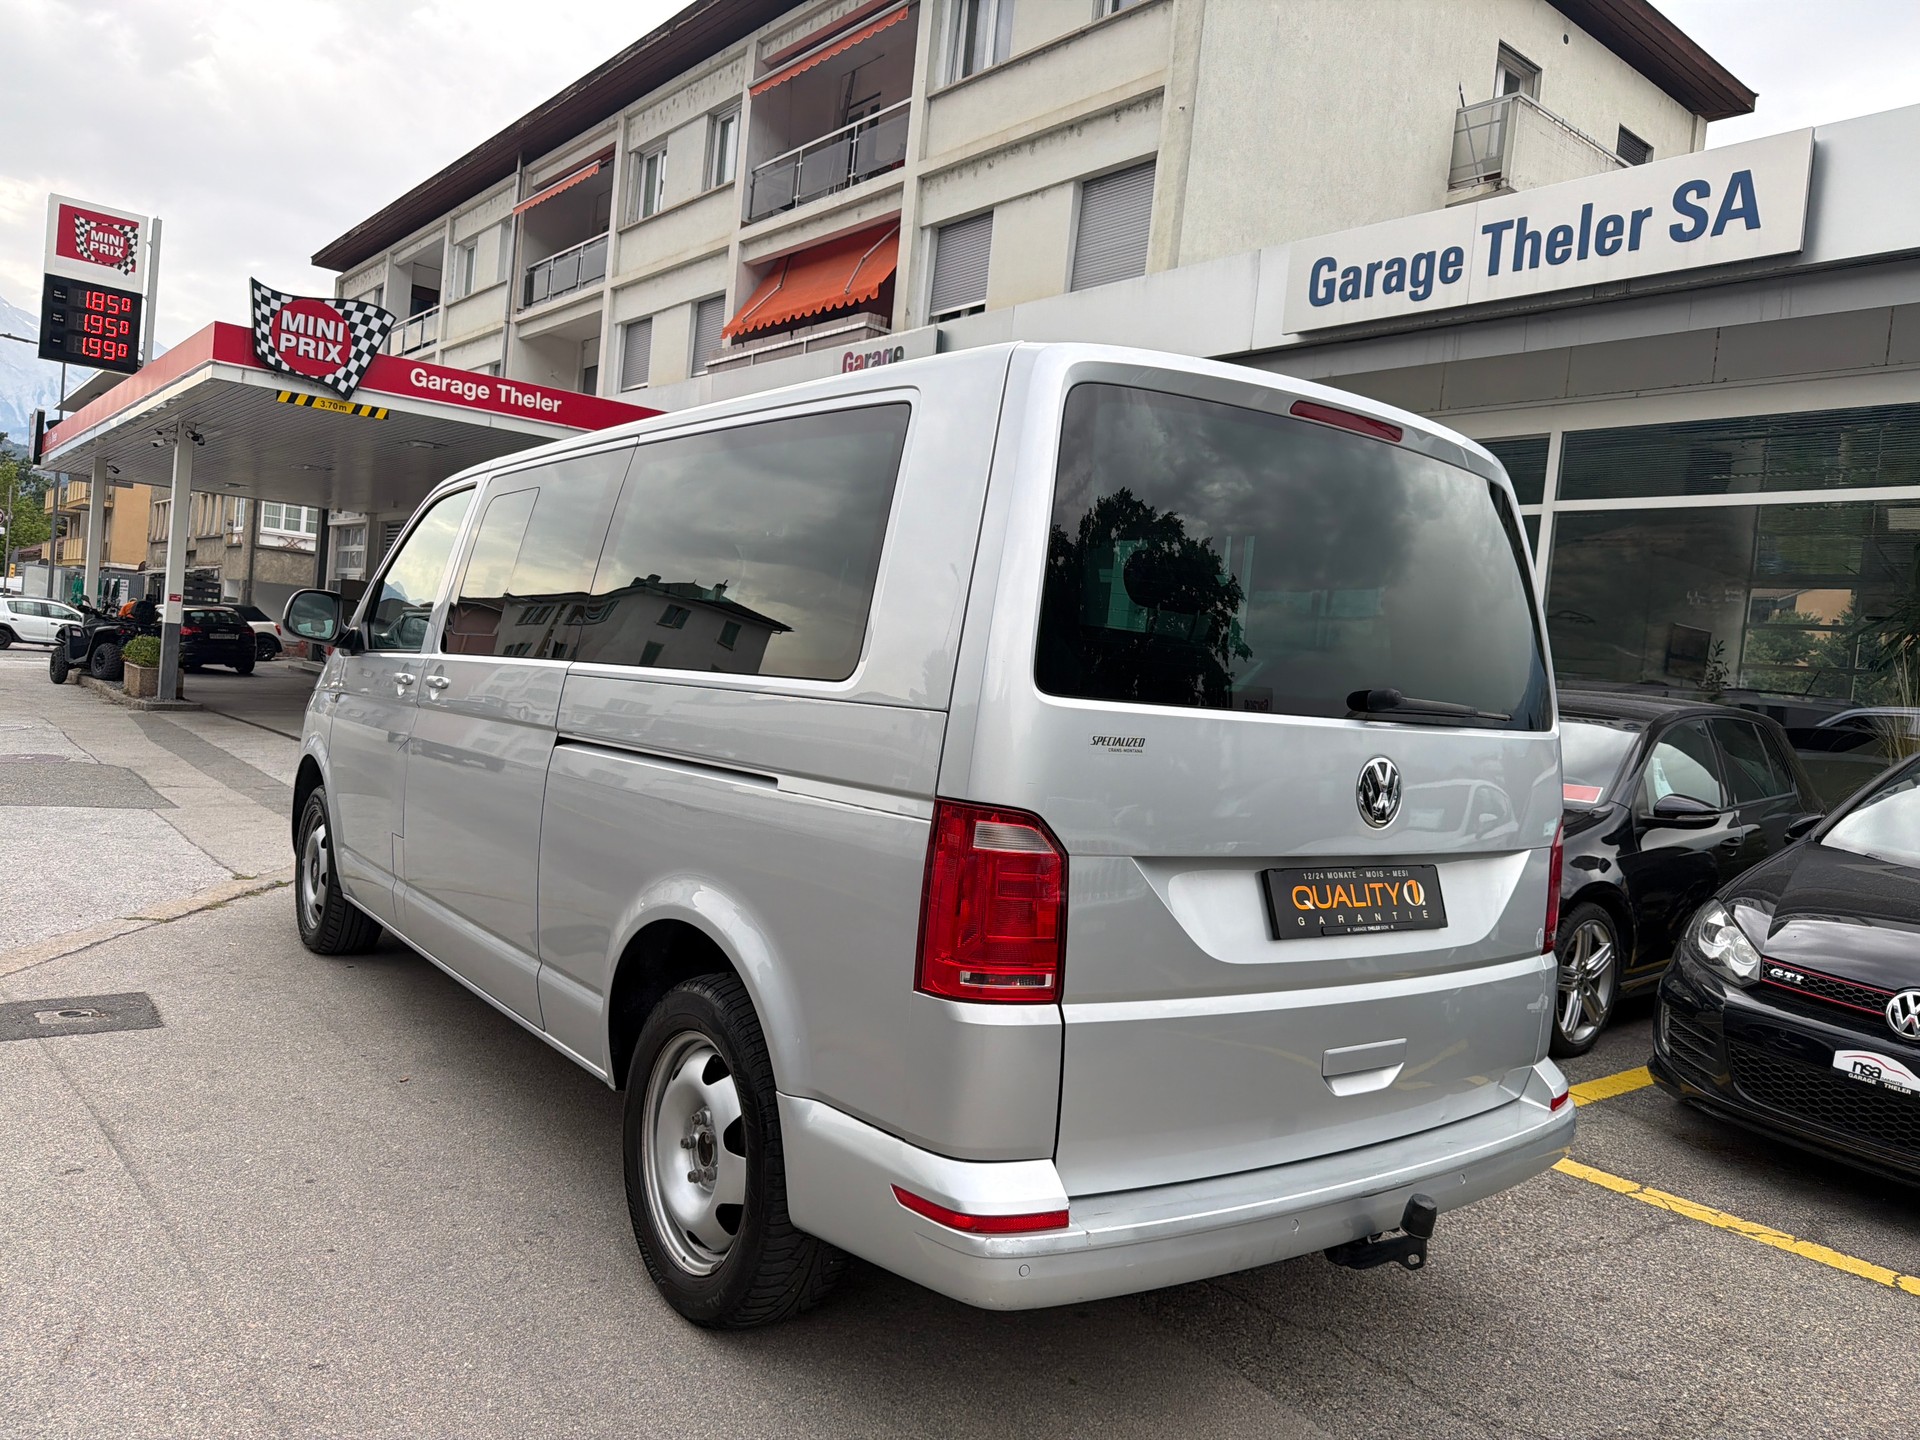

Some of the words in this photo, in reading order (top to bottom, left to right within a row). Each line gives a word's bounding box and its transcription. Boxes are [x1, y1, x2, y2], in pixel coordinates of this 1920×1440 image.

[90, 229, 124, 247] MINI
[1309, 243, 1463, 307] Garage
[1481, 203, 1653, 276] Theler
[1668, 169, 1762, 243] SA
[90, 241, 123, 258] PRIX
[281, 309, 344, 342] MINI
[279, 333, 343, 365] PRIX
[410, 368, 490, 401] Garage
[497, 384, 562, 413] Theler
[1090, 735, 1146, 748] SPECIALIZED
[1303, 872, 1325, 880] 12/24
[1327, 871, 1357, 880] MONATE
[1366, 870, 1384, 878] MOIS
[1392, 869, 1409, 877] MESI
[1292, 882, 1400, 910] QUALITY
[1297, 910, 1429, 926] GARANTIE
[1770, 968, 1805, 985] GTI
[1852, 1060, 1882, 1080] nsa
[1848, 1072, 1877, 1085] GARAGE
[1884, 1082, 1912, 1095] THELER
